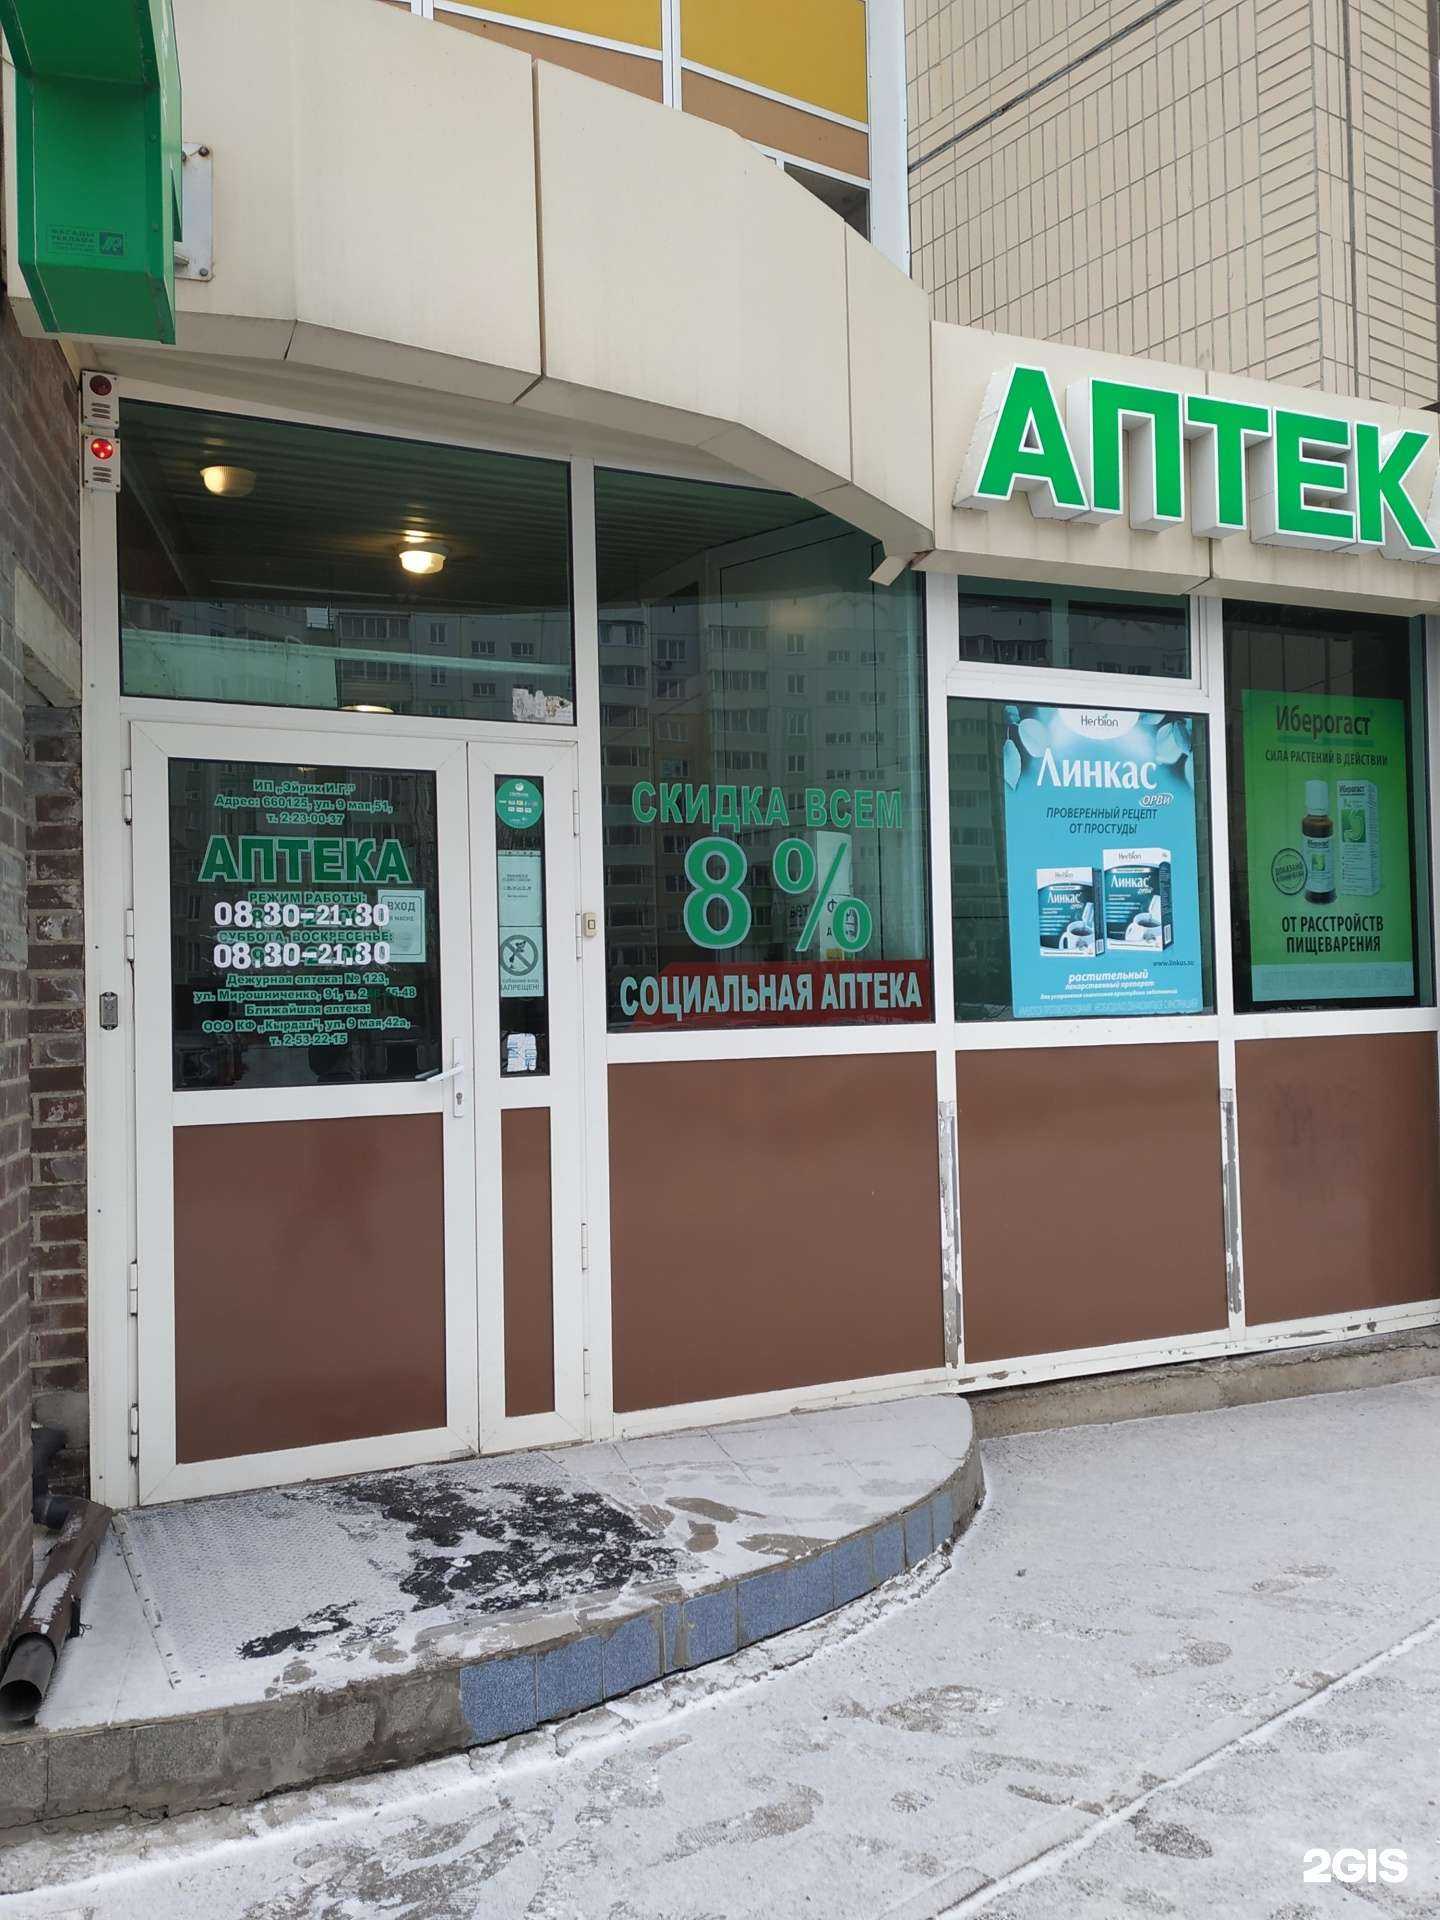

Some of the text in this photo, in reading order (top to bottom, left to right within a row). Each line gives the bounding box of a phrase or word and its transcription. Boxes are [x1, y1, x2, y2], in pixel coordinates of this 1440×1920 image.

[974, 362, 1440, 552] АПТЕК
[1081, 713, 1119, 727] Herbion
[1276, 704, 1371, 740] Иберогаст
[1265, 749, 1388, 767] СИЛА РАСТЕНИЙ В ДЕЙСТВИИ
[1036, 747, 1157, 790] Линкас
[254, 780, 274, 793] ИП
[214, 794, 260, 809] Адрес:
[262, 796, 312, 811] 660125,
[314, 799, 335, 812] ул.
[336, 799, 346, 811] 9
[631, 781, 903, 833] СКИДКА ВСЕМ
[1142, 794, 1171, 806] ОРВИ
[266, 812, 345, 826] т. 2-23-00-37
[1046, 807, 1158, 821] ПРОВЕРЕННЫЙ РЕЦЕПТ
[1069, 823, 1138, 835] ОТ ПРОСТУДЫ
[198, 834, 413, 884] АПТЕКА
[1111, 875, 1148, 889] Линкас
[248, 891, 368, 905] РЕЖИМ РАБОТЫ:
[214, 900, 390, 928] 08.30-21.30
[387, 901, 416, 913] ВХОД
[1282, 914, 1384, 932] ОТ РАССТРОЙСТВ
[218, 930, 393, 944] СУББОТА, ВОСКРЕСЕНЬЕ:
[1286, 936, 1381, 956] ПИЩЕВАРЕНИЯ
[213, 941, 391, 969] 08.30-21.30
[226, 973, 389, 987] Дежурная аптека: № 123,
[1068, 969, 1149, 984] растительный
[193, 991, 216, 1004] ул.
[218, 989, 322, 1003] Мирошниченко,
[323, 988, 344, 1002] 91,
[345, 990, 357, 1001] т.
[620, 971, 923, 1022] СОЦИАЛЬНАЯ АПТЕКА
[245, 1003, 372, 1016] Ближайшая аптека:
[202, 1020, 234, 1032] ООО
[235, 1020, 257, 1032] КФ
[324, 1019, 346, 1031] ул.
[346, 1017, 357, 1029] 9
[269, 1034, 348, 1047] т. 2-53-22-15
